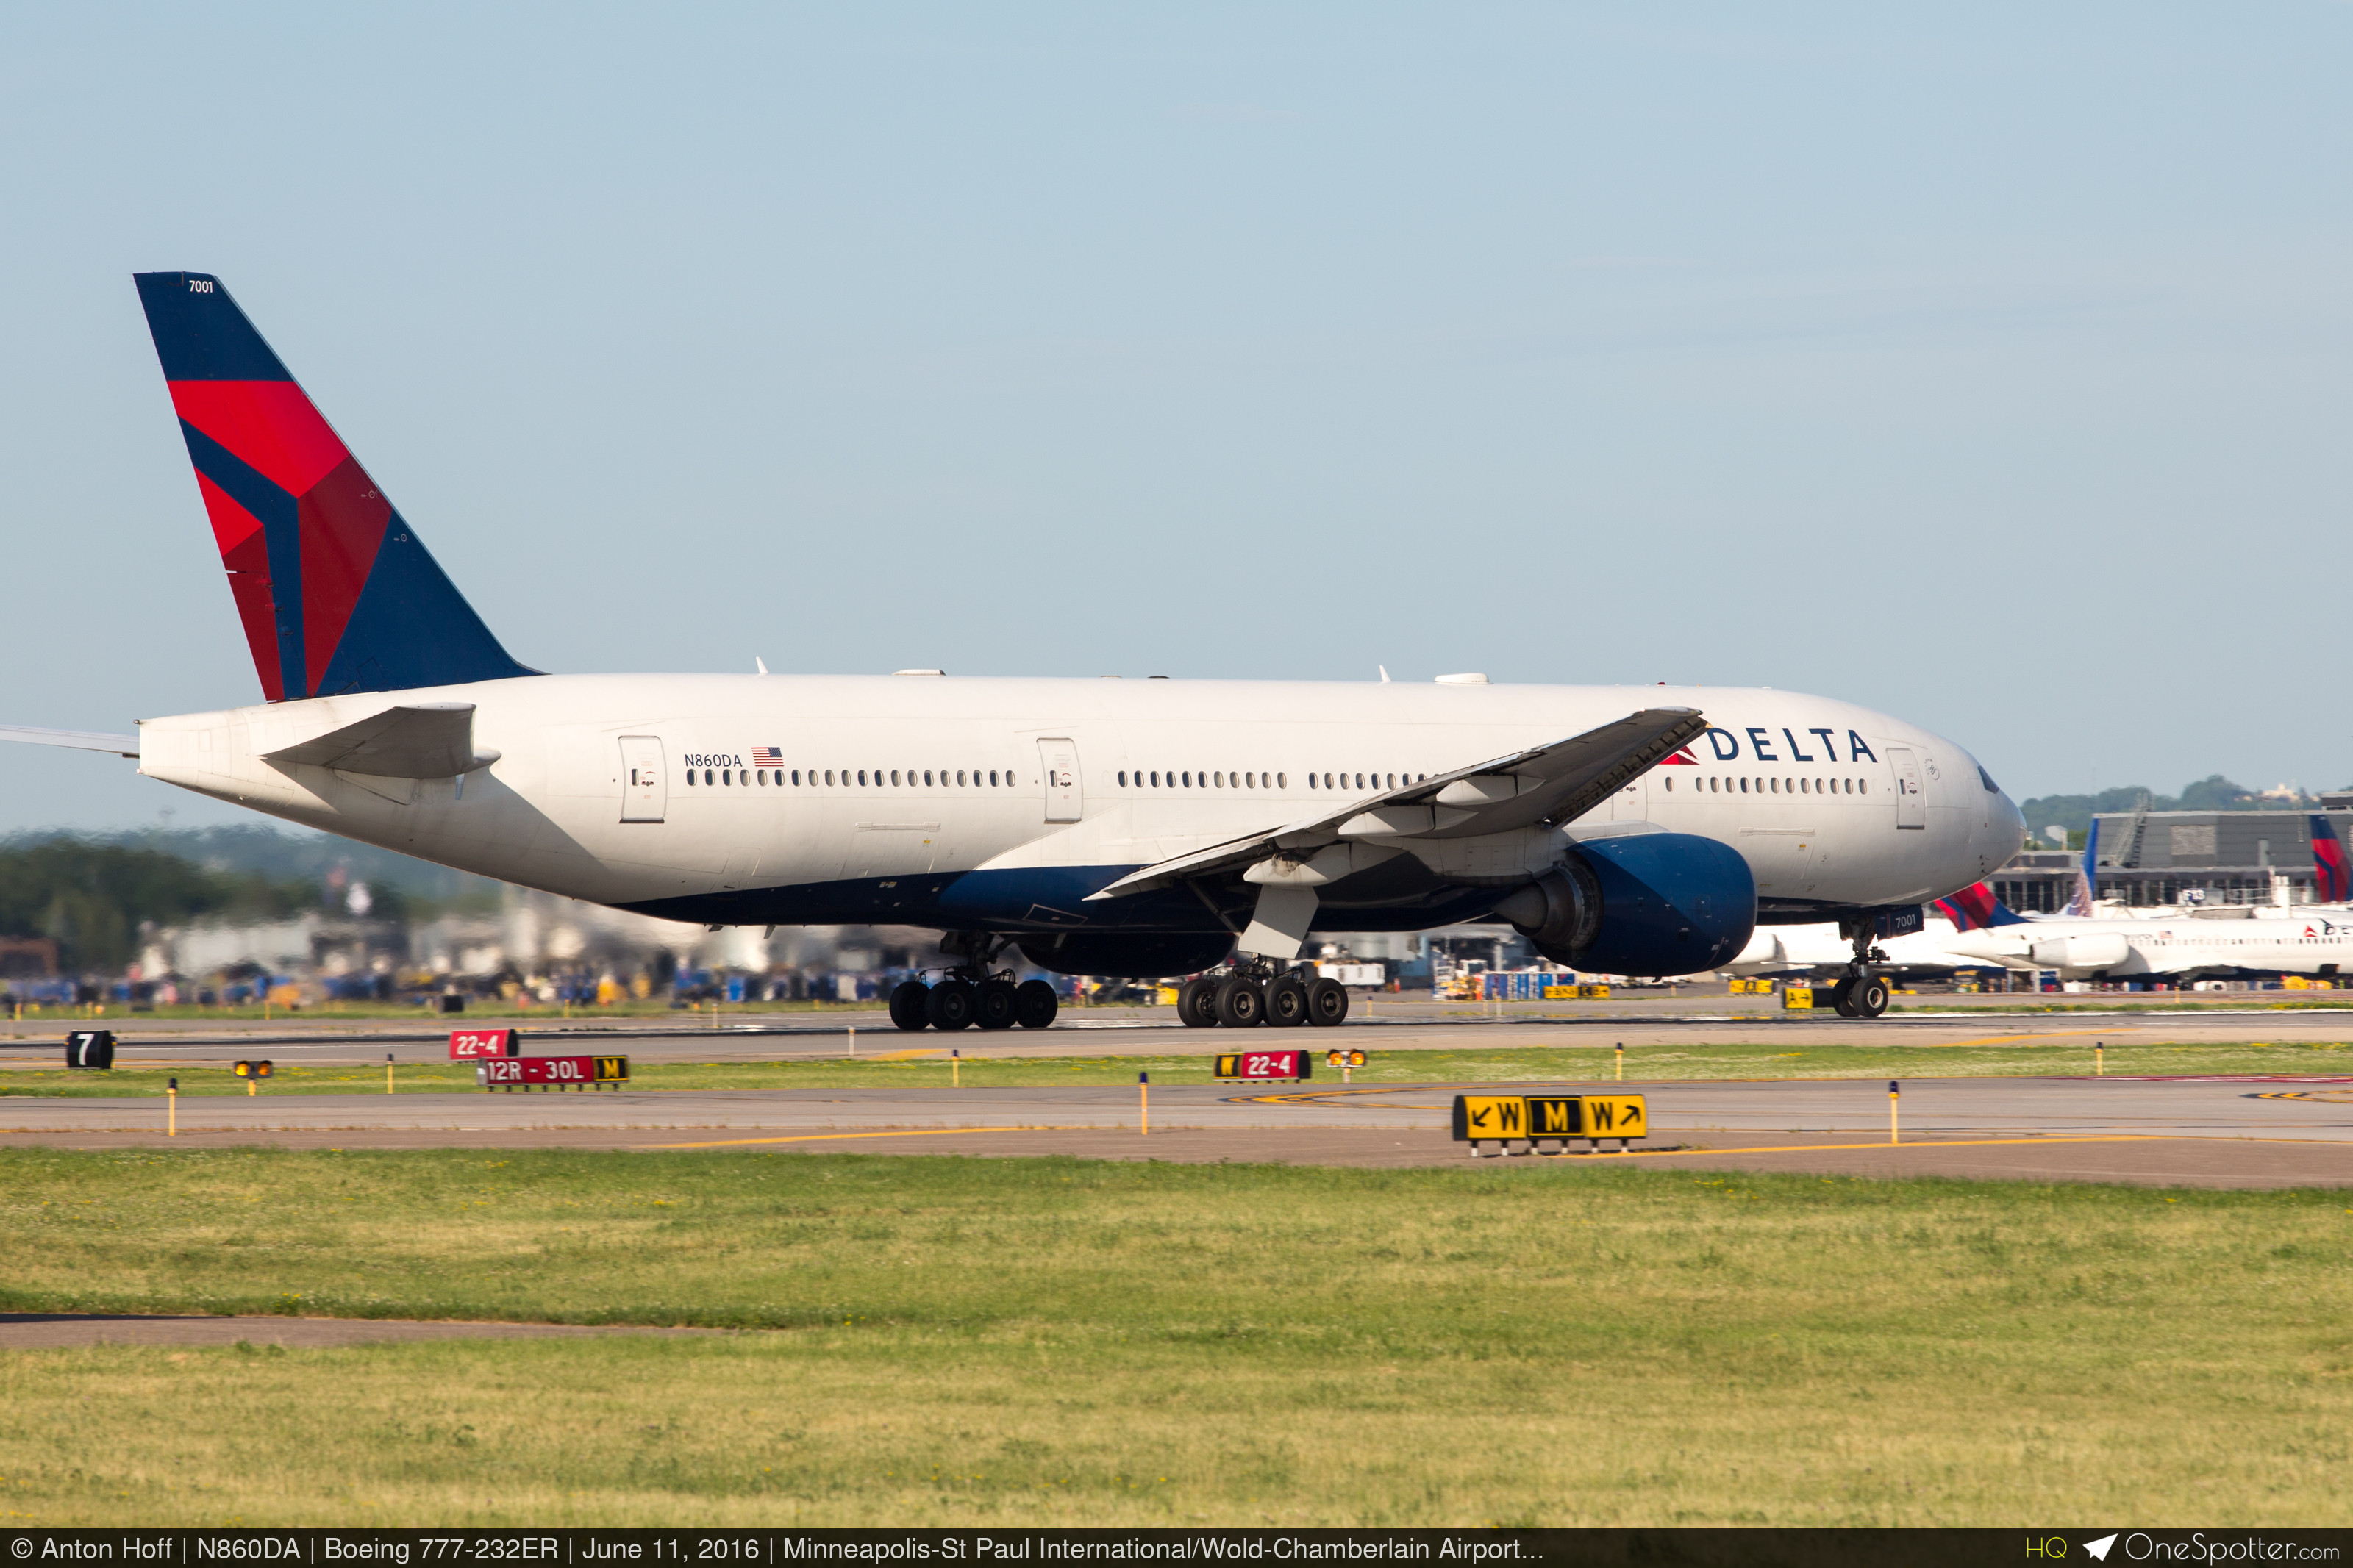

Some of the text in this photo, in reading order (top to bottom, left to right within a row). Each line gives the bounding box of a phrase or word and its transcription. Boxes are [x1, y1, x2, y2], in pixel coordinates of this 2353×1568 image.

[189, 280, 213, 293] 7001
[1707, 727, 1879, 763] DELTA
[684, 753, 743, 767] N860DA
[1895, 913, 1917, 929] 7001
[1787, 992, 1799, 1005] A
[76, 1033, 95, 1066] 7
[457, 1034, 499, 1055] 22-4
[487, 1061, 522, 1081] 12R
[545, 1060, 585, 1080] 30L
[603, 1059, 620, 1078] M
[1247, 1055, 1291, 1075] 22-4
[1496, 1101, 1613, 1131] W M W
